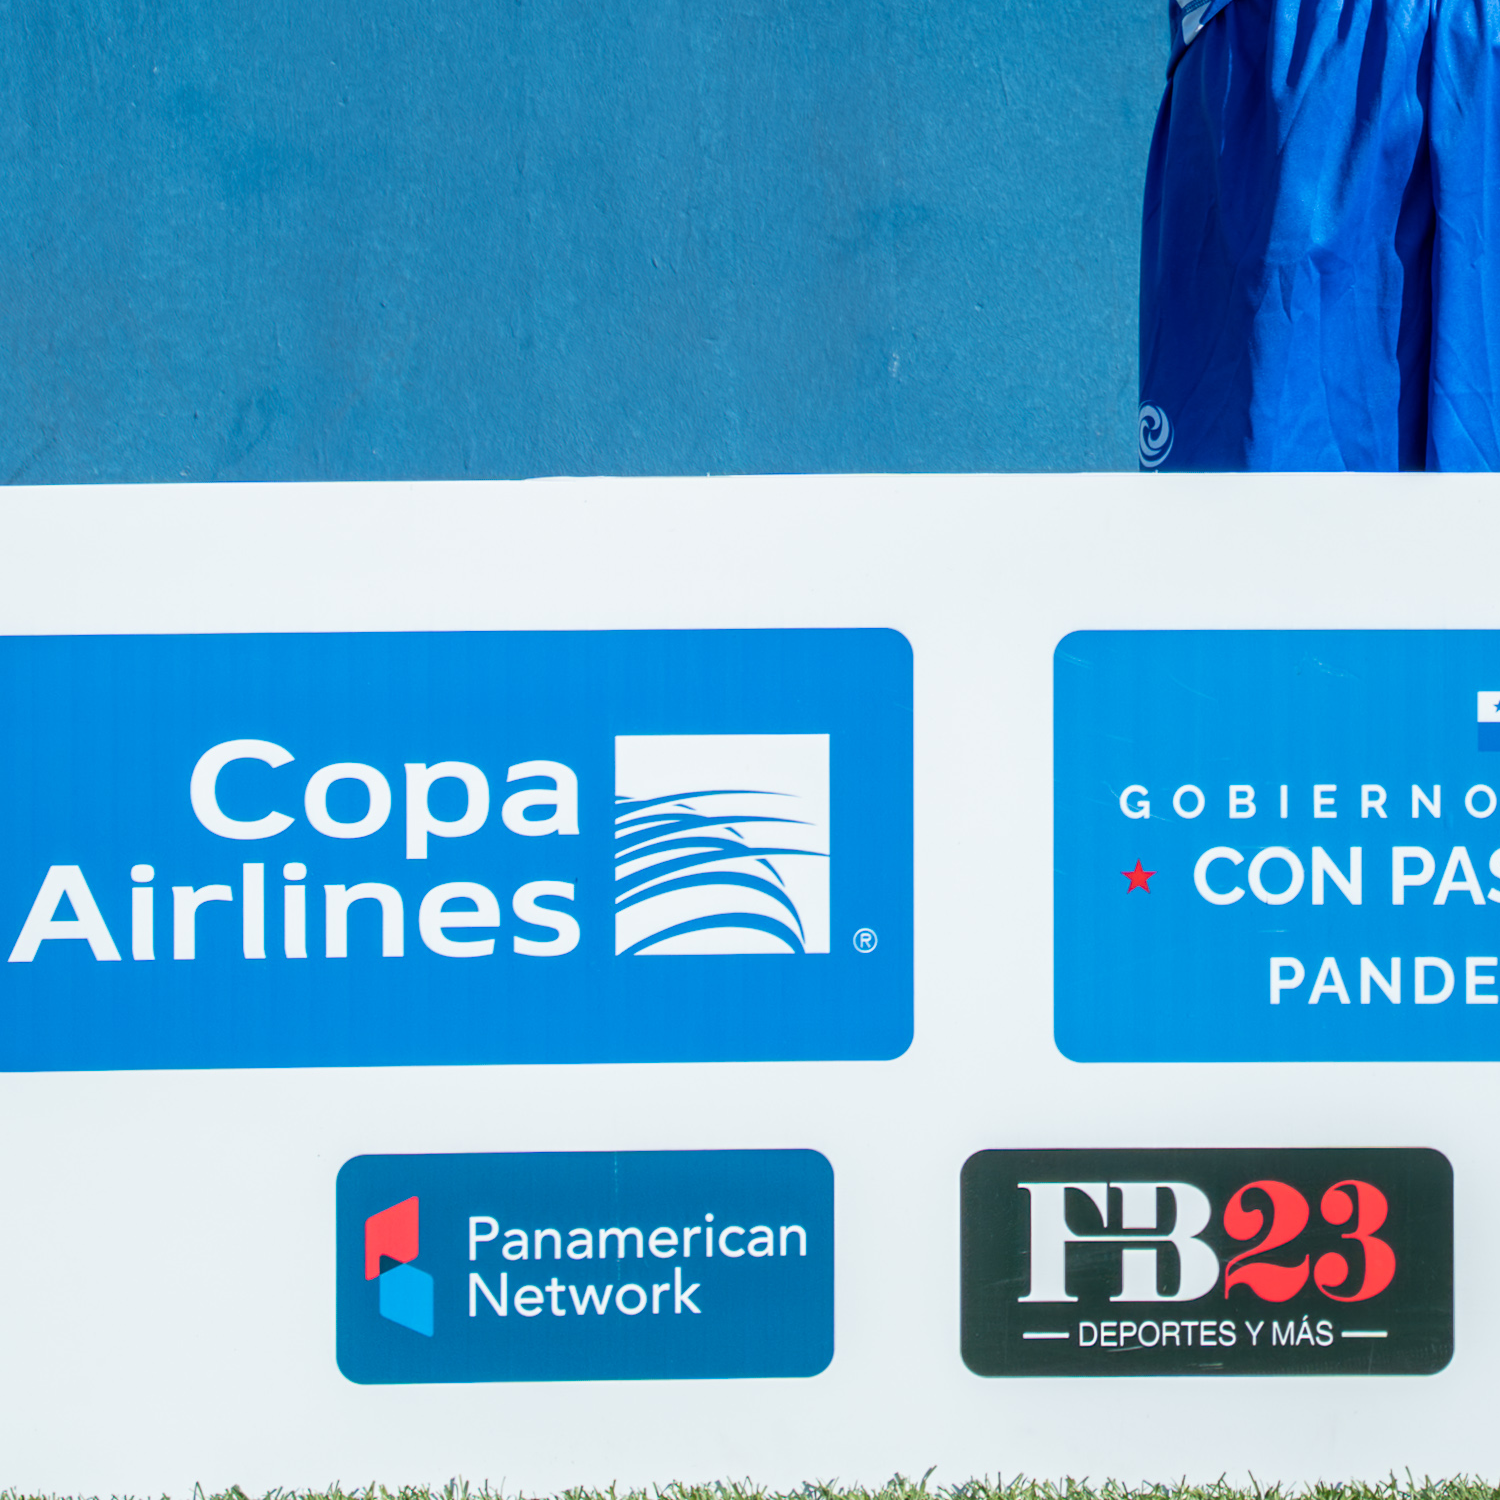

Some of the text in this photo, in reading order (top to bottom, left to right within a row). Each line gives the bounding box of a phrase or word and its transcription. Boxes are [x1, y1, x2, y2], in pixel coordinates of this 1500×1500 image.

[190, 739, 580, 859] Copa
[1119, 784, 1498, 820] GOBIERNO
[1193, 846, 1362, 906] CON
[7, 863, 581, 963] Airlines
[469, 1213, 807, 1263] Panamerican
[1017, 1179, 1396, 1303] FB23
[469, 1267, 702, 1318] Network
[1078, 1315, 1334, 1347] DEPORTES Y MÁS
